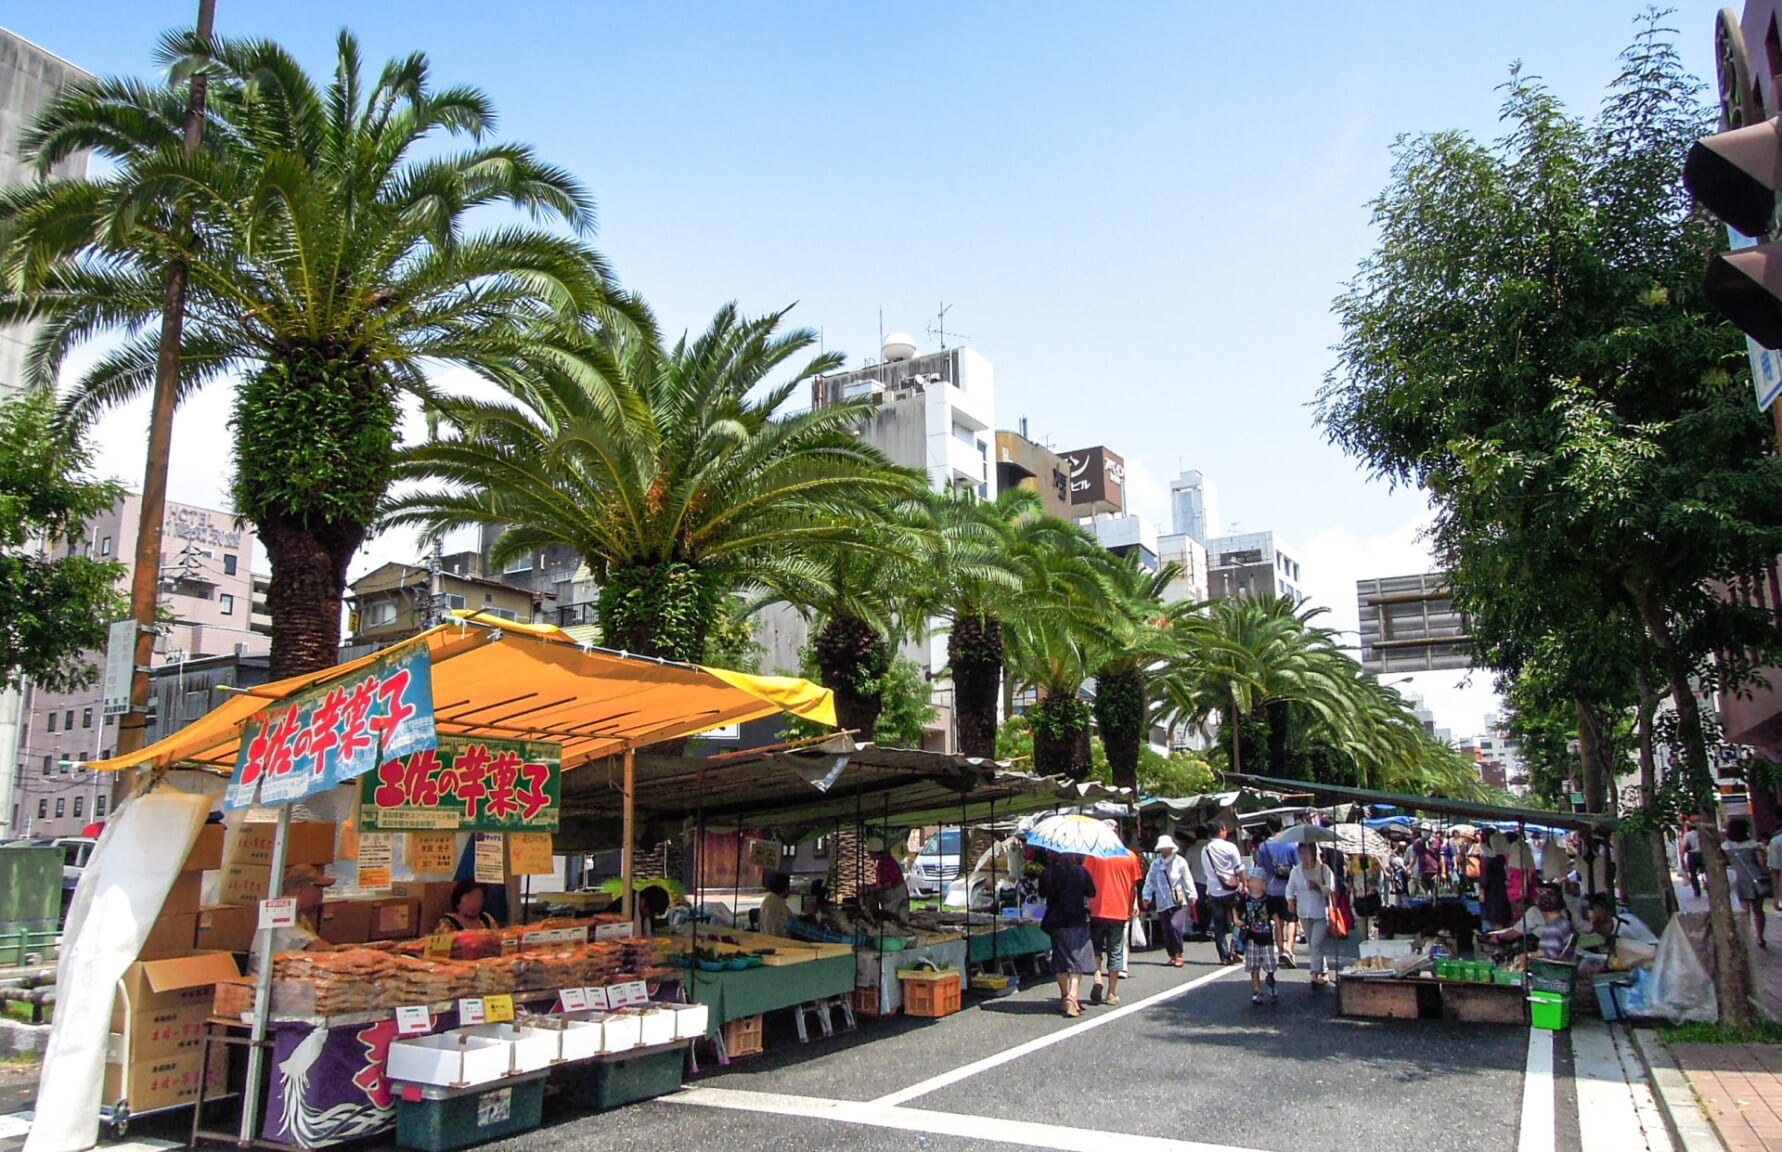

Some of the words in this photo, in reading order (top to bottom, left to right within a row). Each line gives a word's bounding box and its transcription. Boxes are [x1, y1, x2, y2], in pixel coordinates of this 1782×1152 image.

[167, 505, 214, 528] HOTEL
[240, 668, 416, 786] 土佐の芋菓子
[374, 744, 552, 821] 土佐の芋菓子
